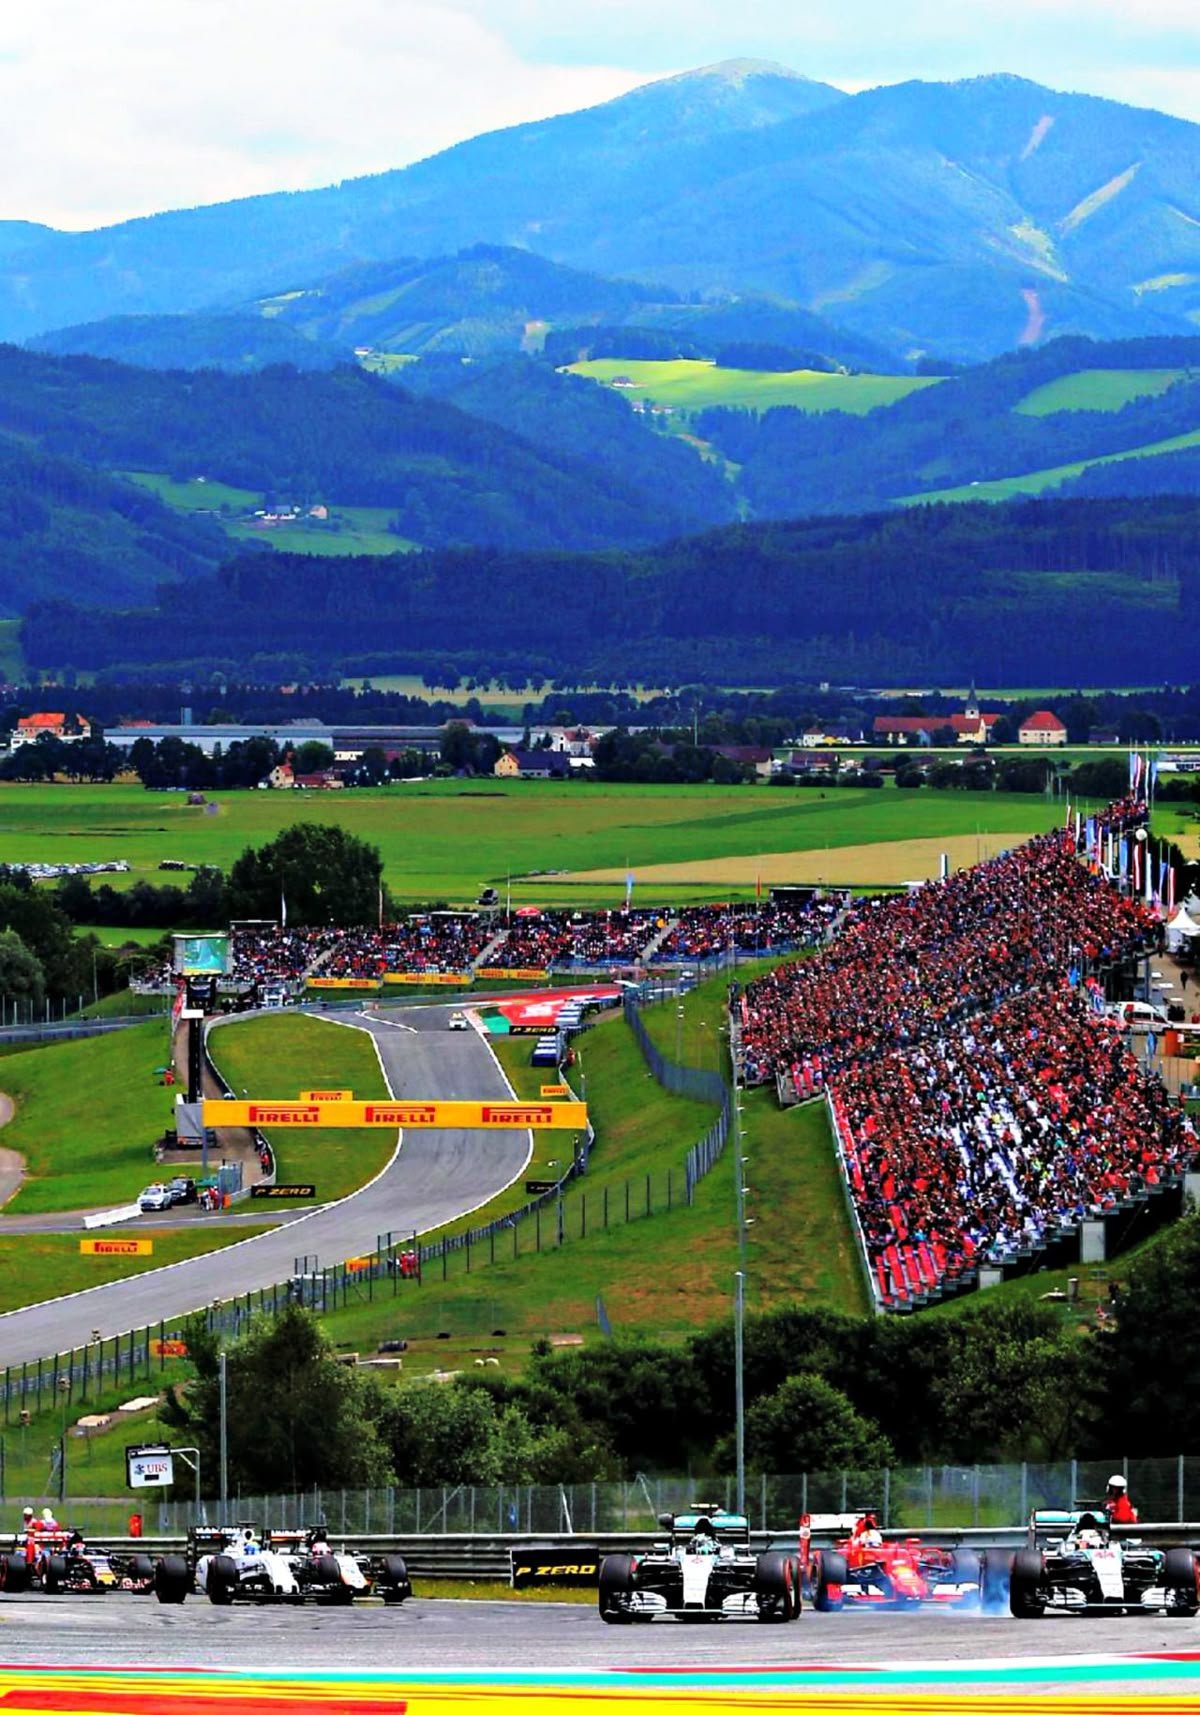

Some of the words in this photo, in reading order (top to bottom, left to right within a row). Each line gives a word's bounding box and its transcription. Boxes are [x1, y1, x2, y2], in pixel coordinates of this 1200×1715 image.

[249, 1107, 319, 1122] PIRELLI
[365, 1107, 435, 1122] PIRELLI
[482, 1107, 552, 1123] PIRELLI
[94, 1242, 138, 1252] PIRELLI
[146, 1463, 168, 1473] UBS
[515, 1567, 531, 1577] P
[534, 1565, 596, 1575] ZERO
